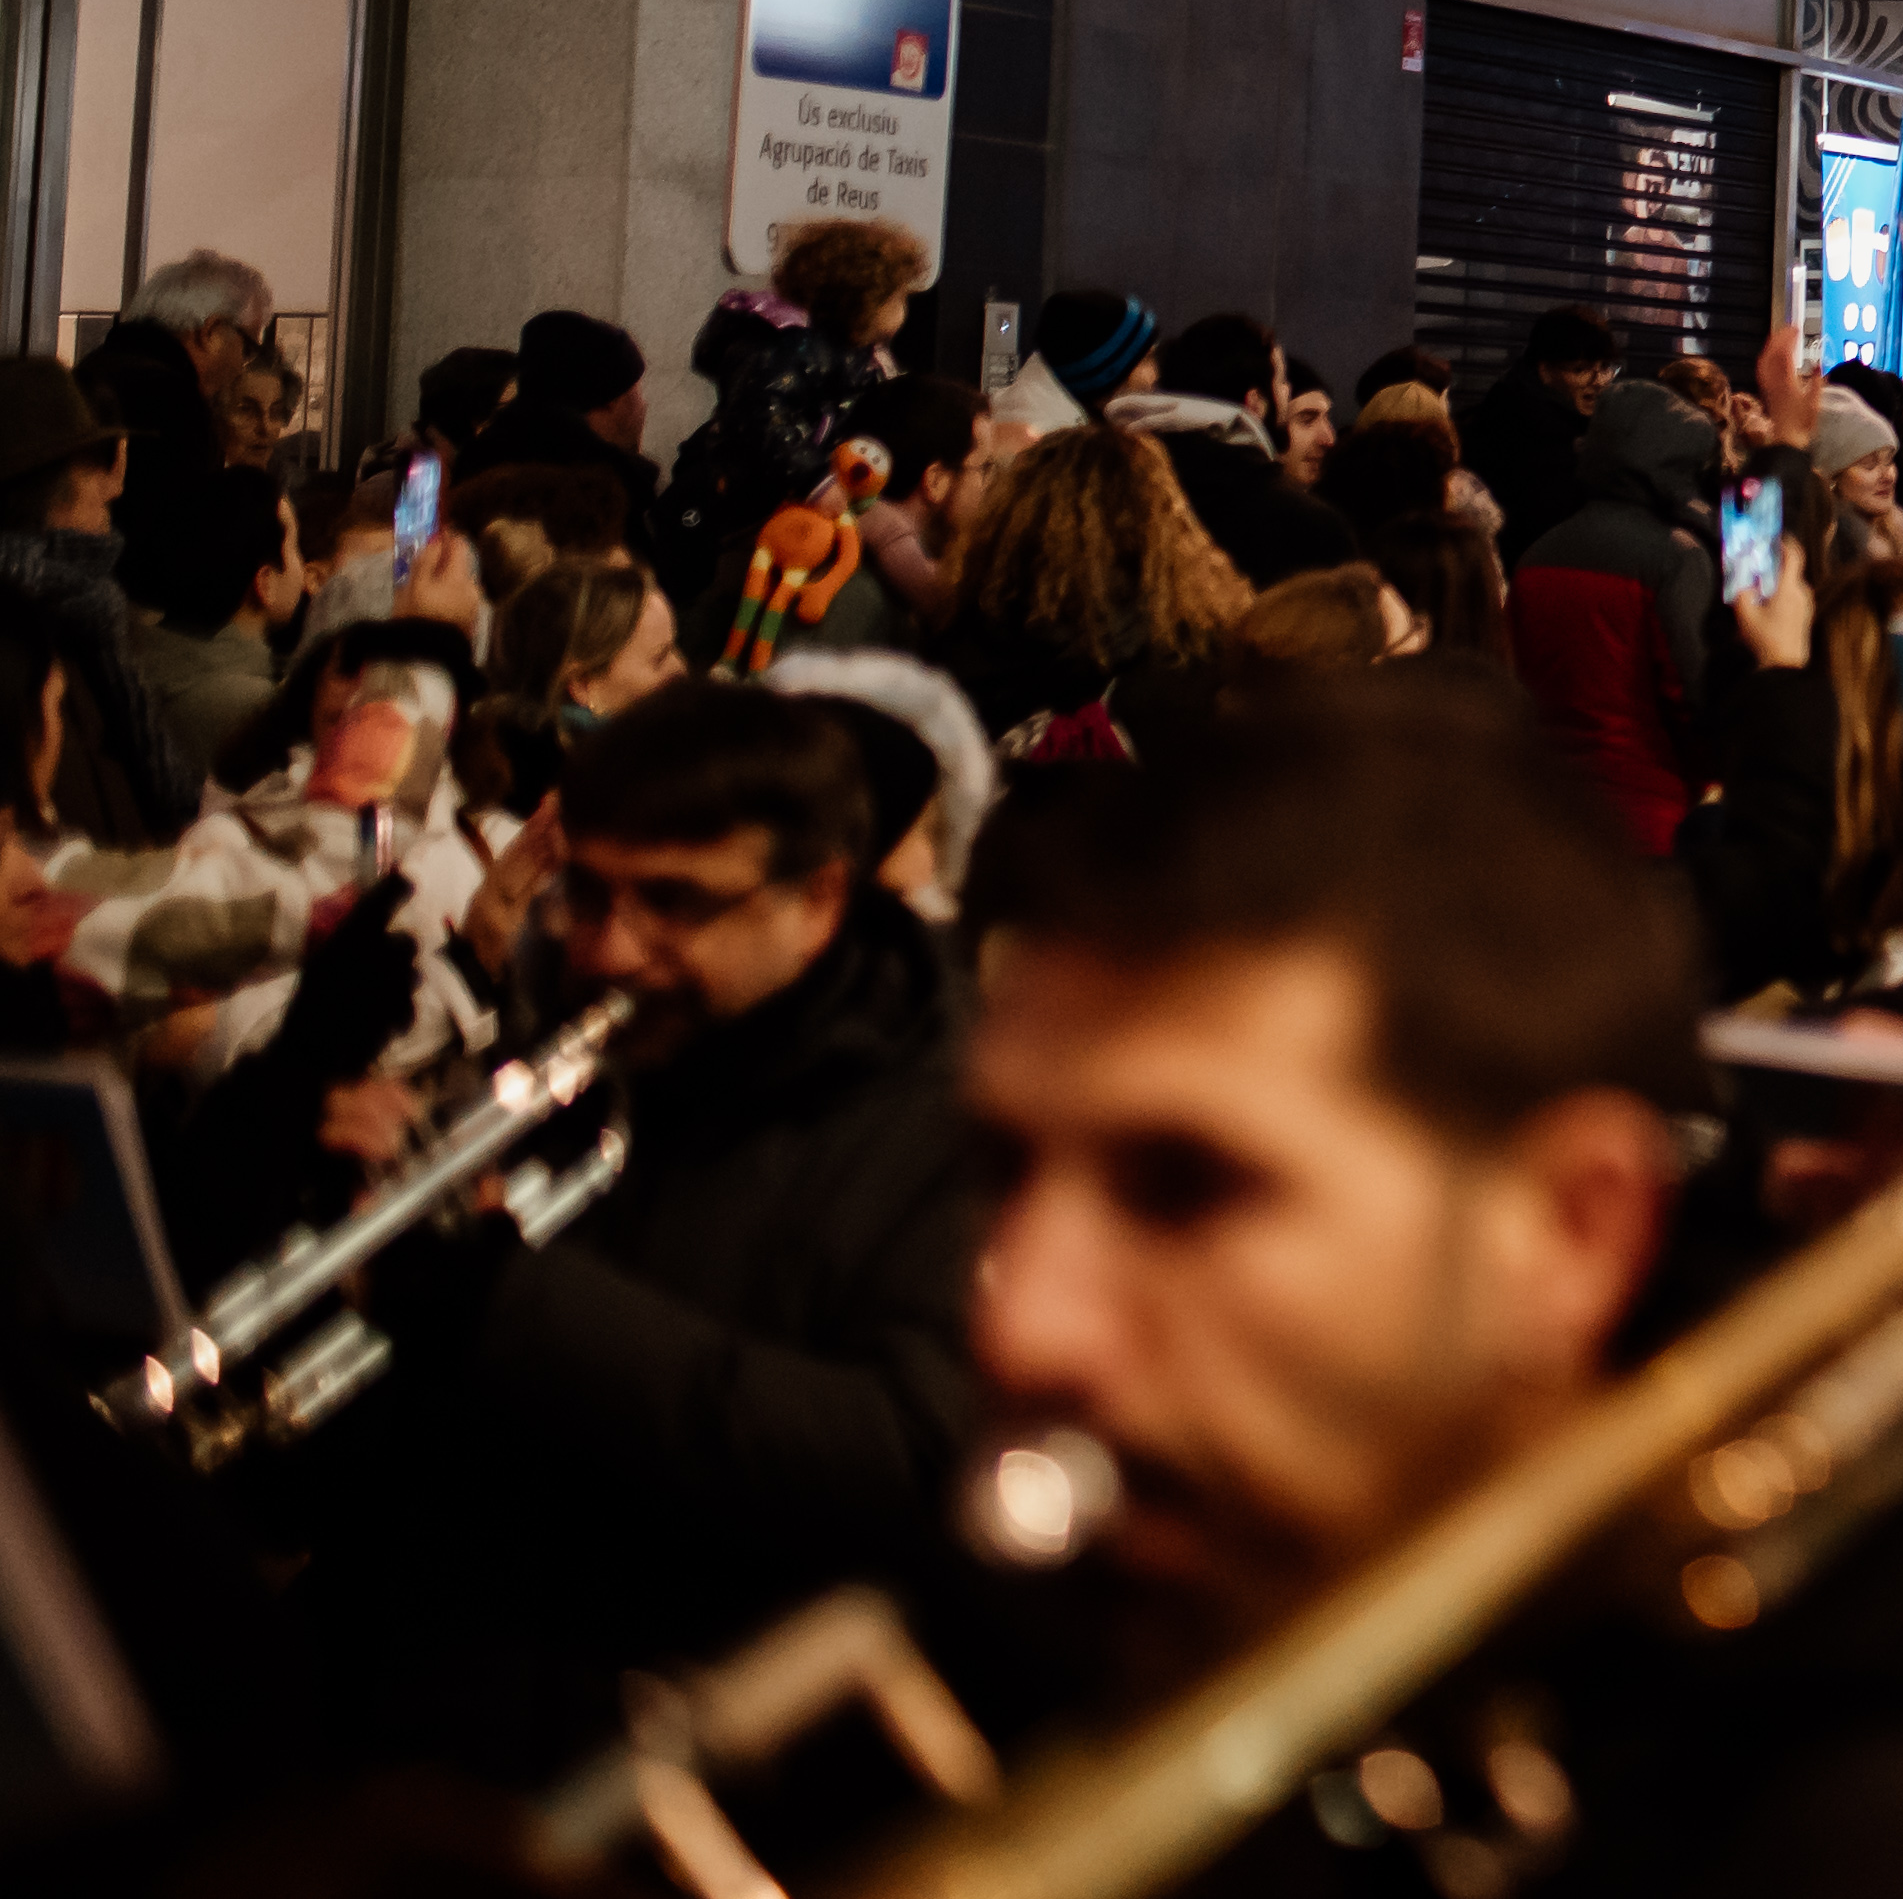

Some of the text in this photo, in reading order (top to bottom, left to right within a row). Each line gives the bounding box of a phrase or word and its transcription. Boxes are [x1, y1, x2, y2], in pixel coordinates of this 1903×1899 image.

[828, 103, 899, 136] exclusiu
[758, 132, 929, 179] Agrupació de Taxis
[806, 176, 880, 212] de Reus
